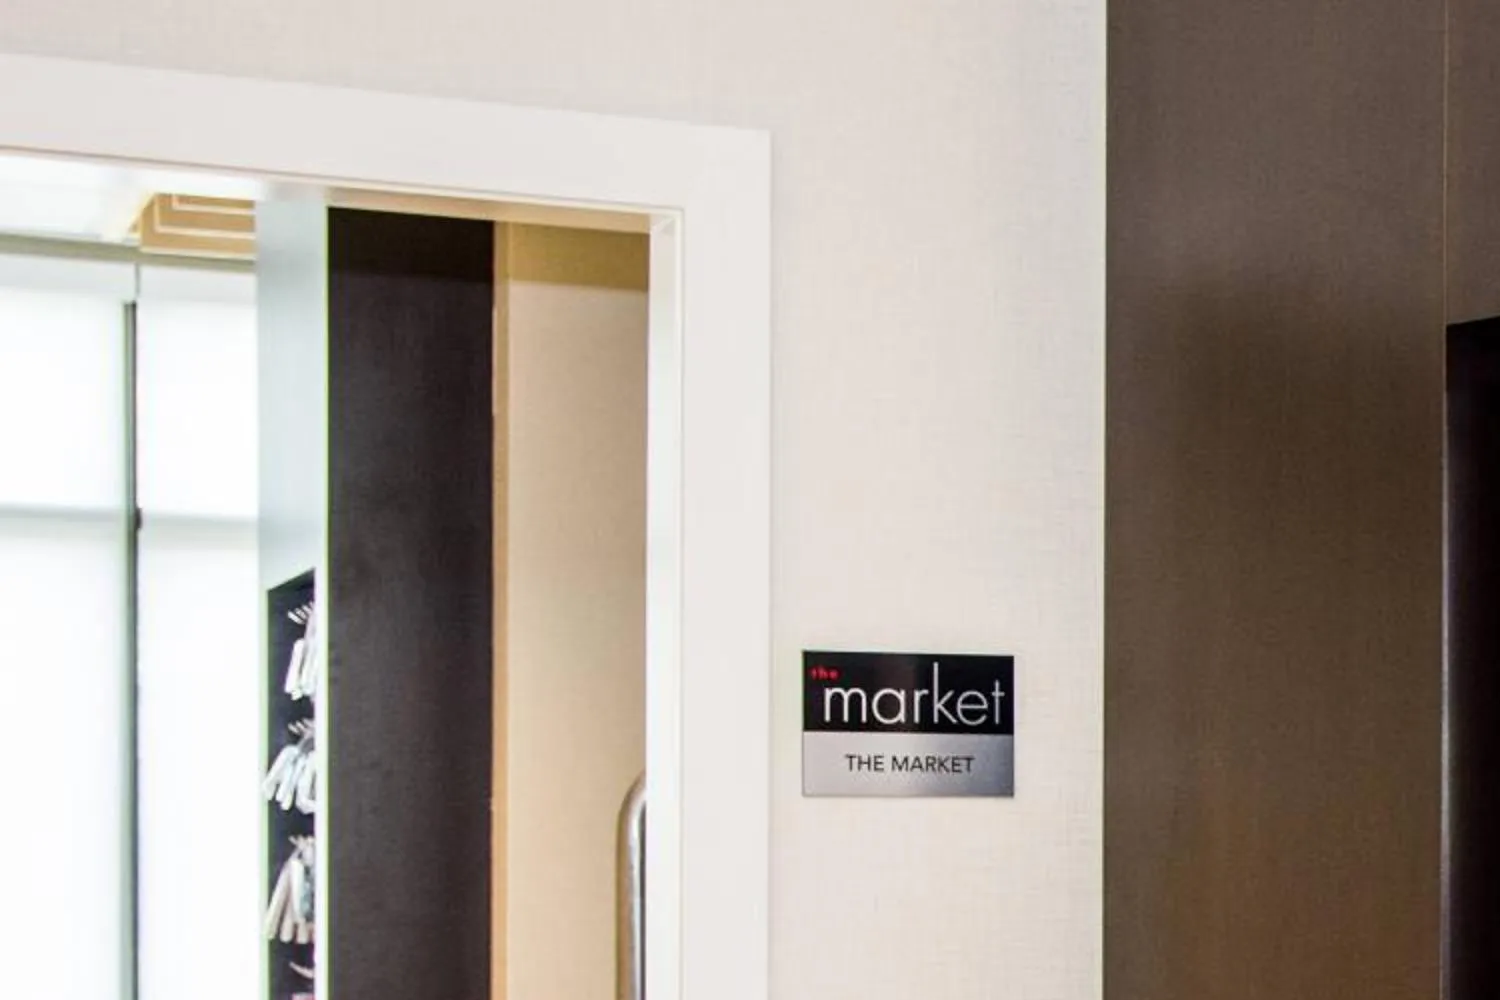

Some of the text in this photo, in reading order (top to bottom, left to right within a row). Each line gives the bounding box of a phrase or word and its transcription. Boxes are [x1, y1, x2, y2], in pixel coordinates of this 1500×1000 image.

[811, 665, 839, 680] the
[824, 661, 1005, 725] market
[845, 754, 975, 774] THE MARKET
